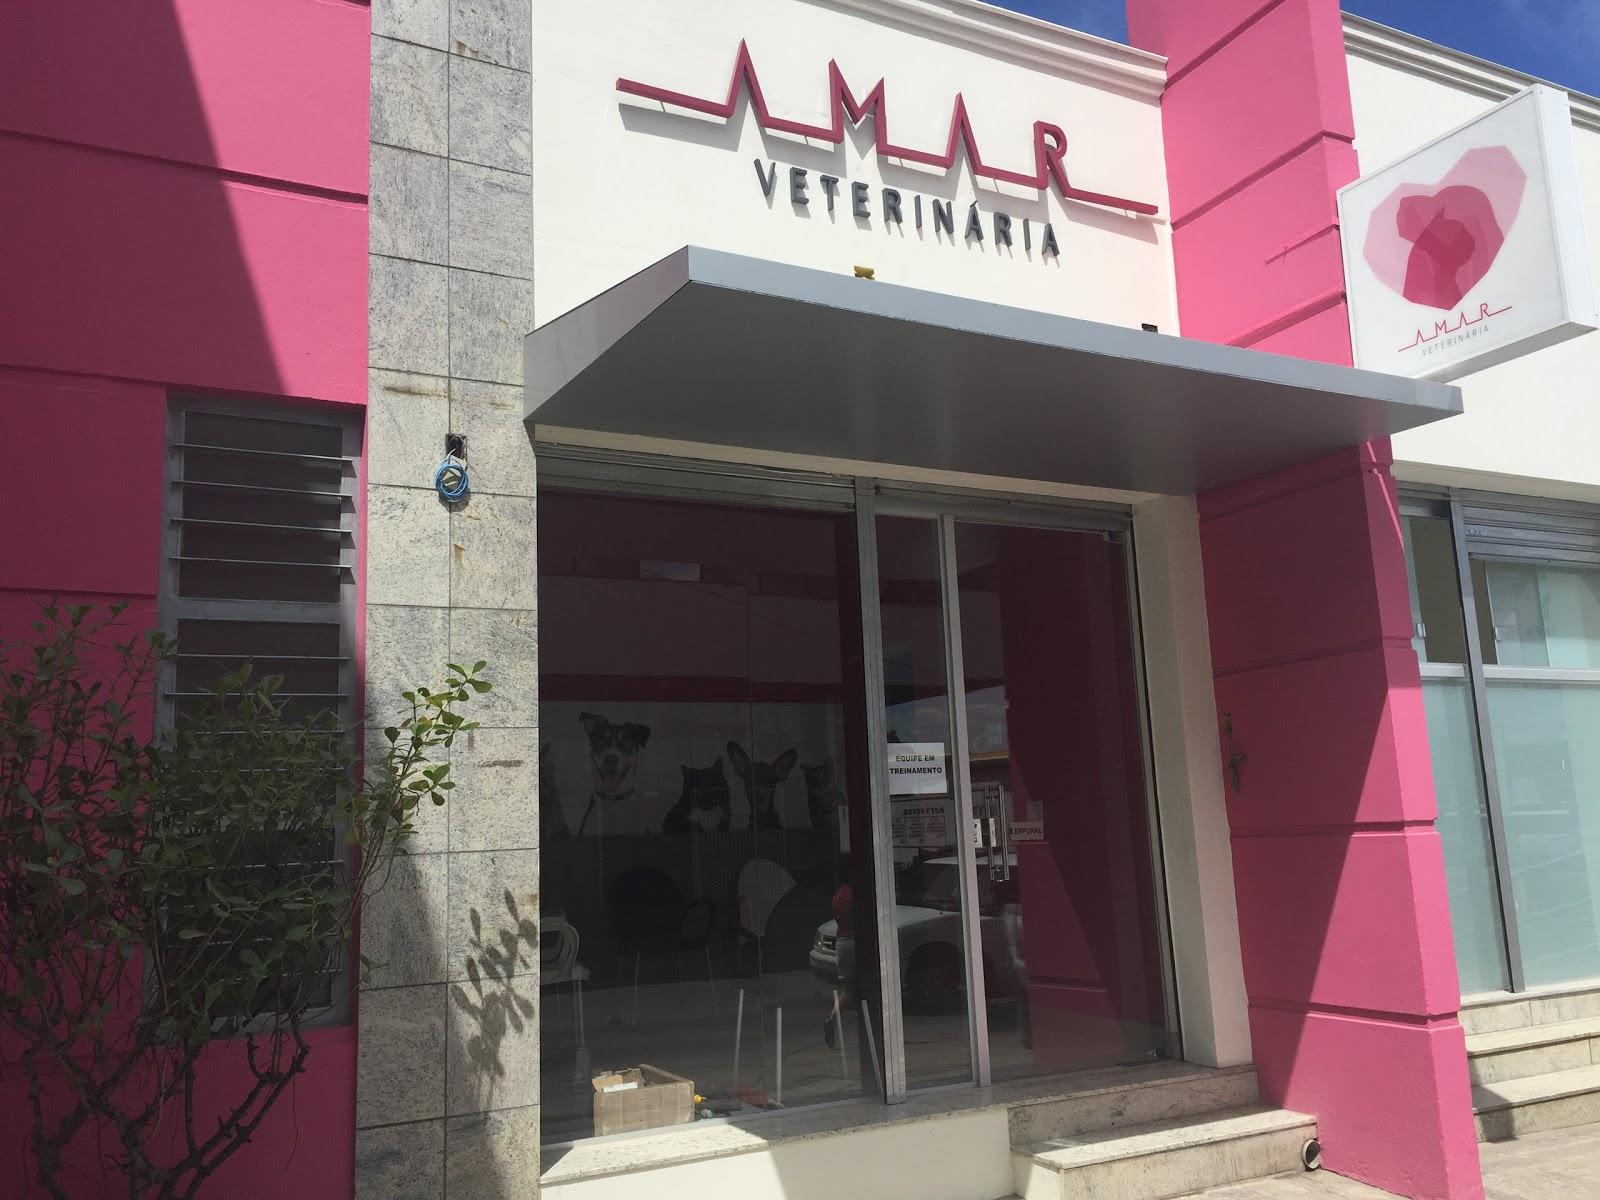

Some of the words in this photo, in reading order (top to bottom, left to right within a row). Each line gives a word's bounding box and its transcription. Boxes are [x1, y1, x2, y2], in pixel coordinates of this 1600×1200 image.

[724, 37, 1072, 199] AMAR
[754, 158, 1060, 257] VETERINÁRIA
[1415, 302, 1491, 346] AMAR
[1421, 324, 1490, 356] VETERINÁRIA
[889, 766, 943, 775] TREINAMENTO
[895, 754, 923, 762] EQUIPE
[924, 754, 935, 762] EM
[1014, 827, 1043, 835] EMPURRE
